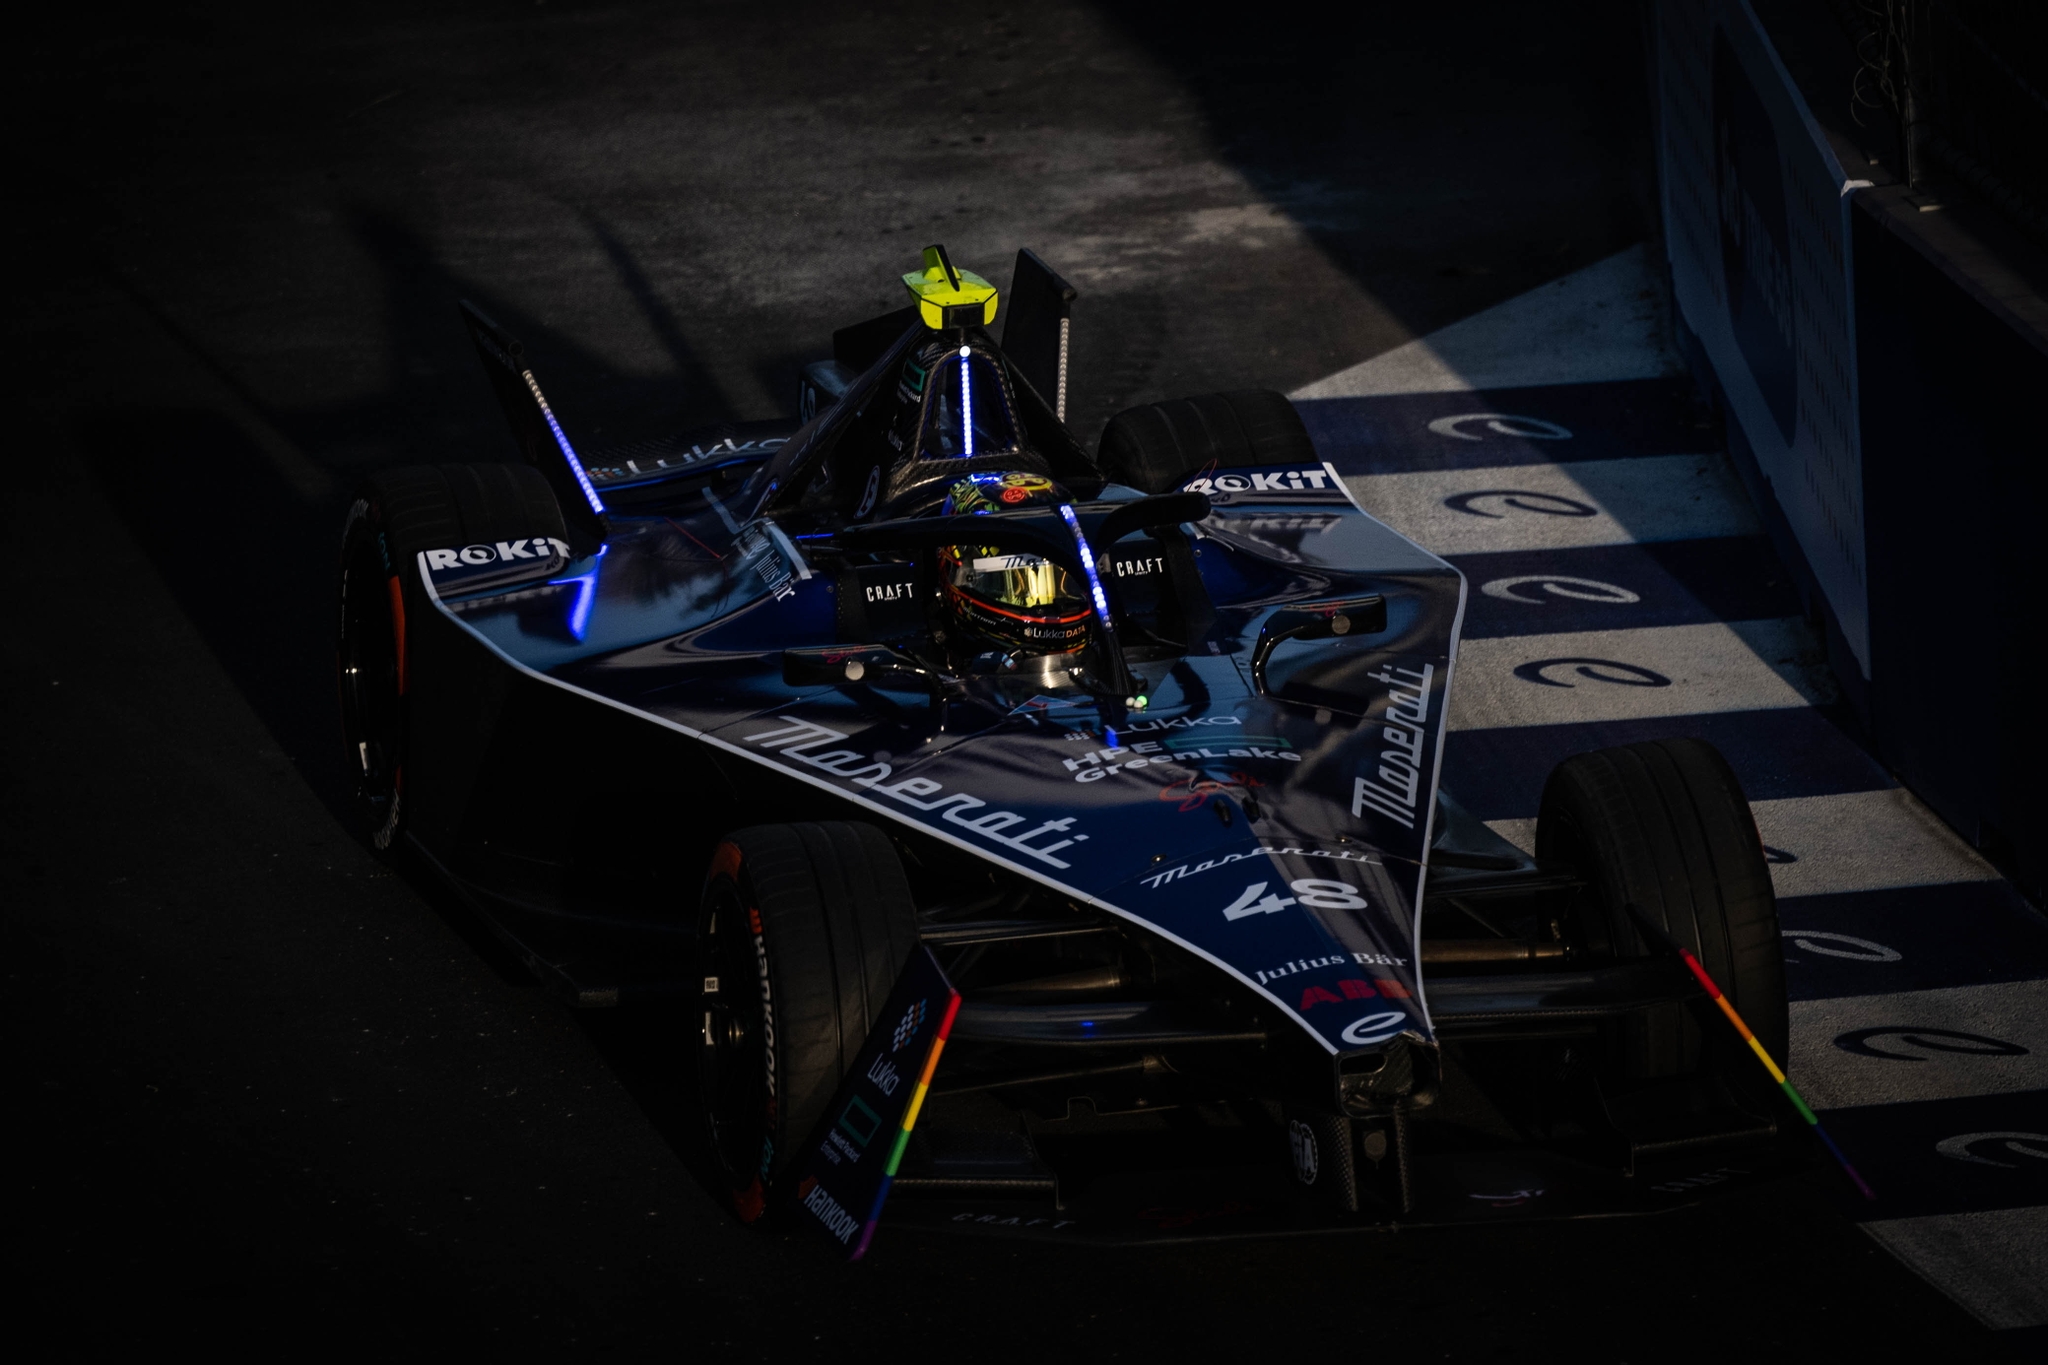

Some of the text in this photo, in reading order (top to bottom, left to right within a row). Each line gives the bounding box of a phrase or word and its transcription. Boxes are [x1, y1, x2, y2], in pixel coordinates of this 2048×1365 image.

[1116, 557, 1163, 577] CRAFT
[866, 582, 913, 602] CRAFT
[1104, 716, 1242, 736] Lukka
[1062, 741, 1164, 772] HPE
[1352, 663, 1434, 830] Maserati
[1075, 746, 1302, 783] GreenLake
[743, 715, 1090, 870] Maserati
[1139, 846, 1383, 889] Maserati
[1222, 878, 1369, 922] 48
[1254, 952, 1408, 986] Julius Bär
